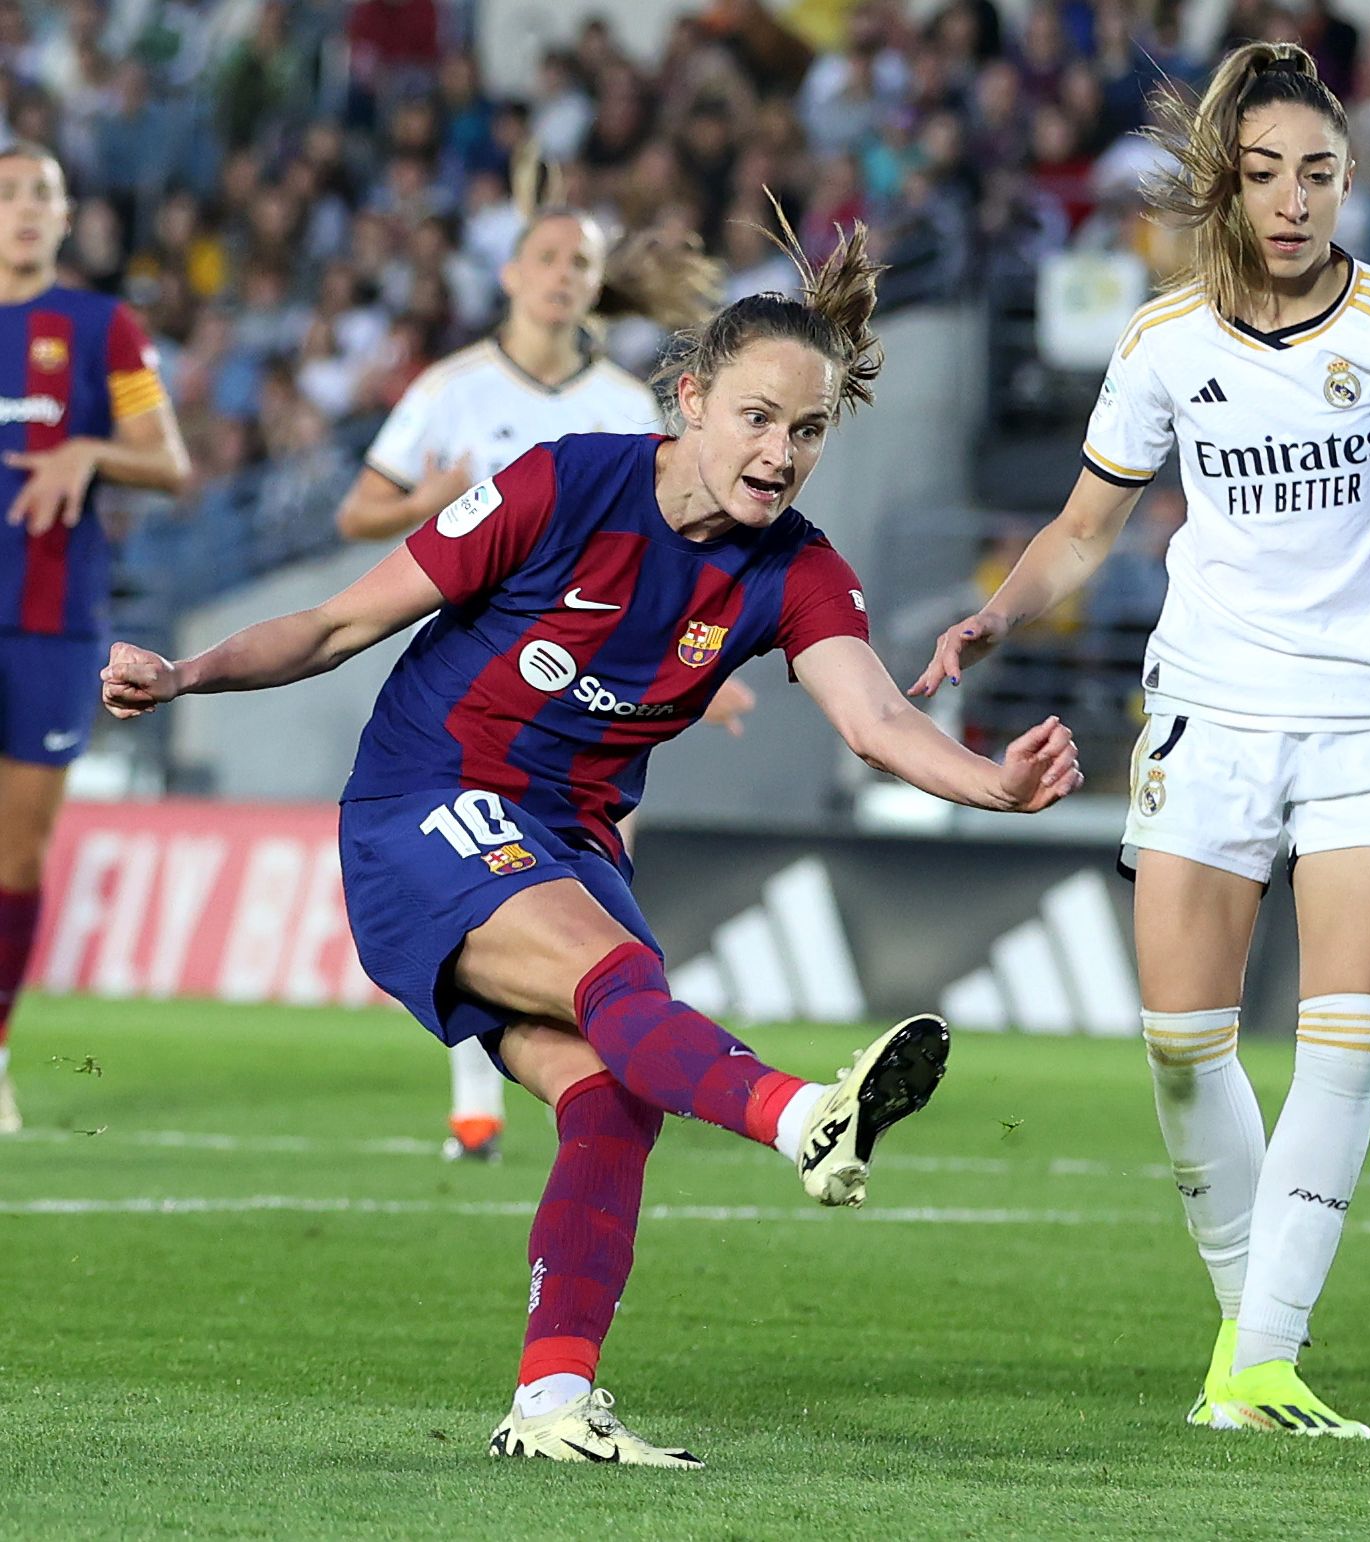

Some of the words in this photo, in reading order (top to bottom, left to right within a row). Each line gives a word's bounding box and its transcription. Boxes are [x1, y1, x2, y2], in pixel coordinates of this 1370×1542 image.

[1228, 483, 1263, 515] FLY
[1275, 473, 1361, 513] BETTER
[419, 789, 524, 859] 10
[44, 829, 230, 994] FLY
